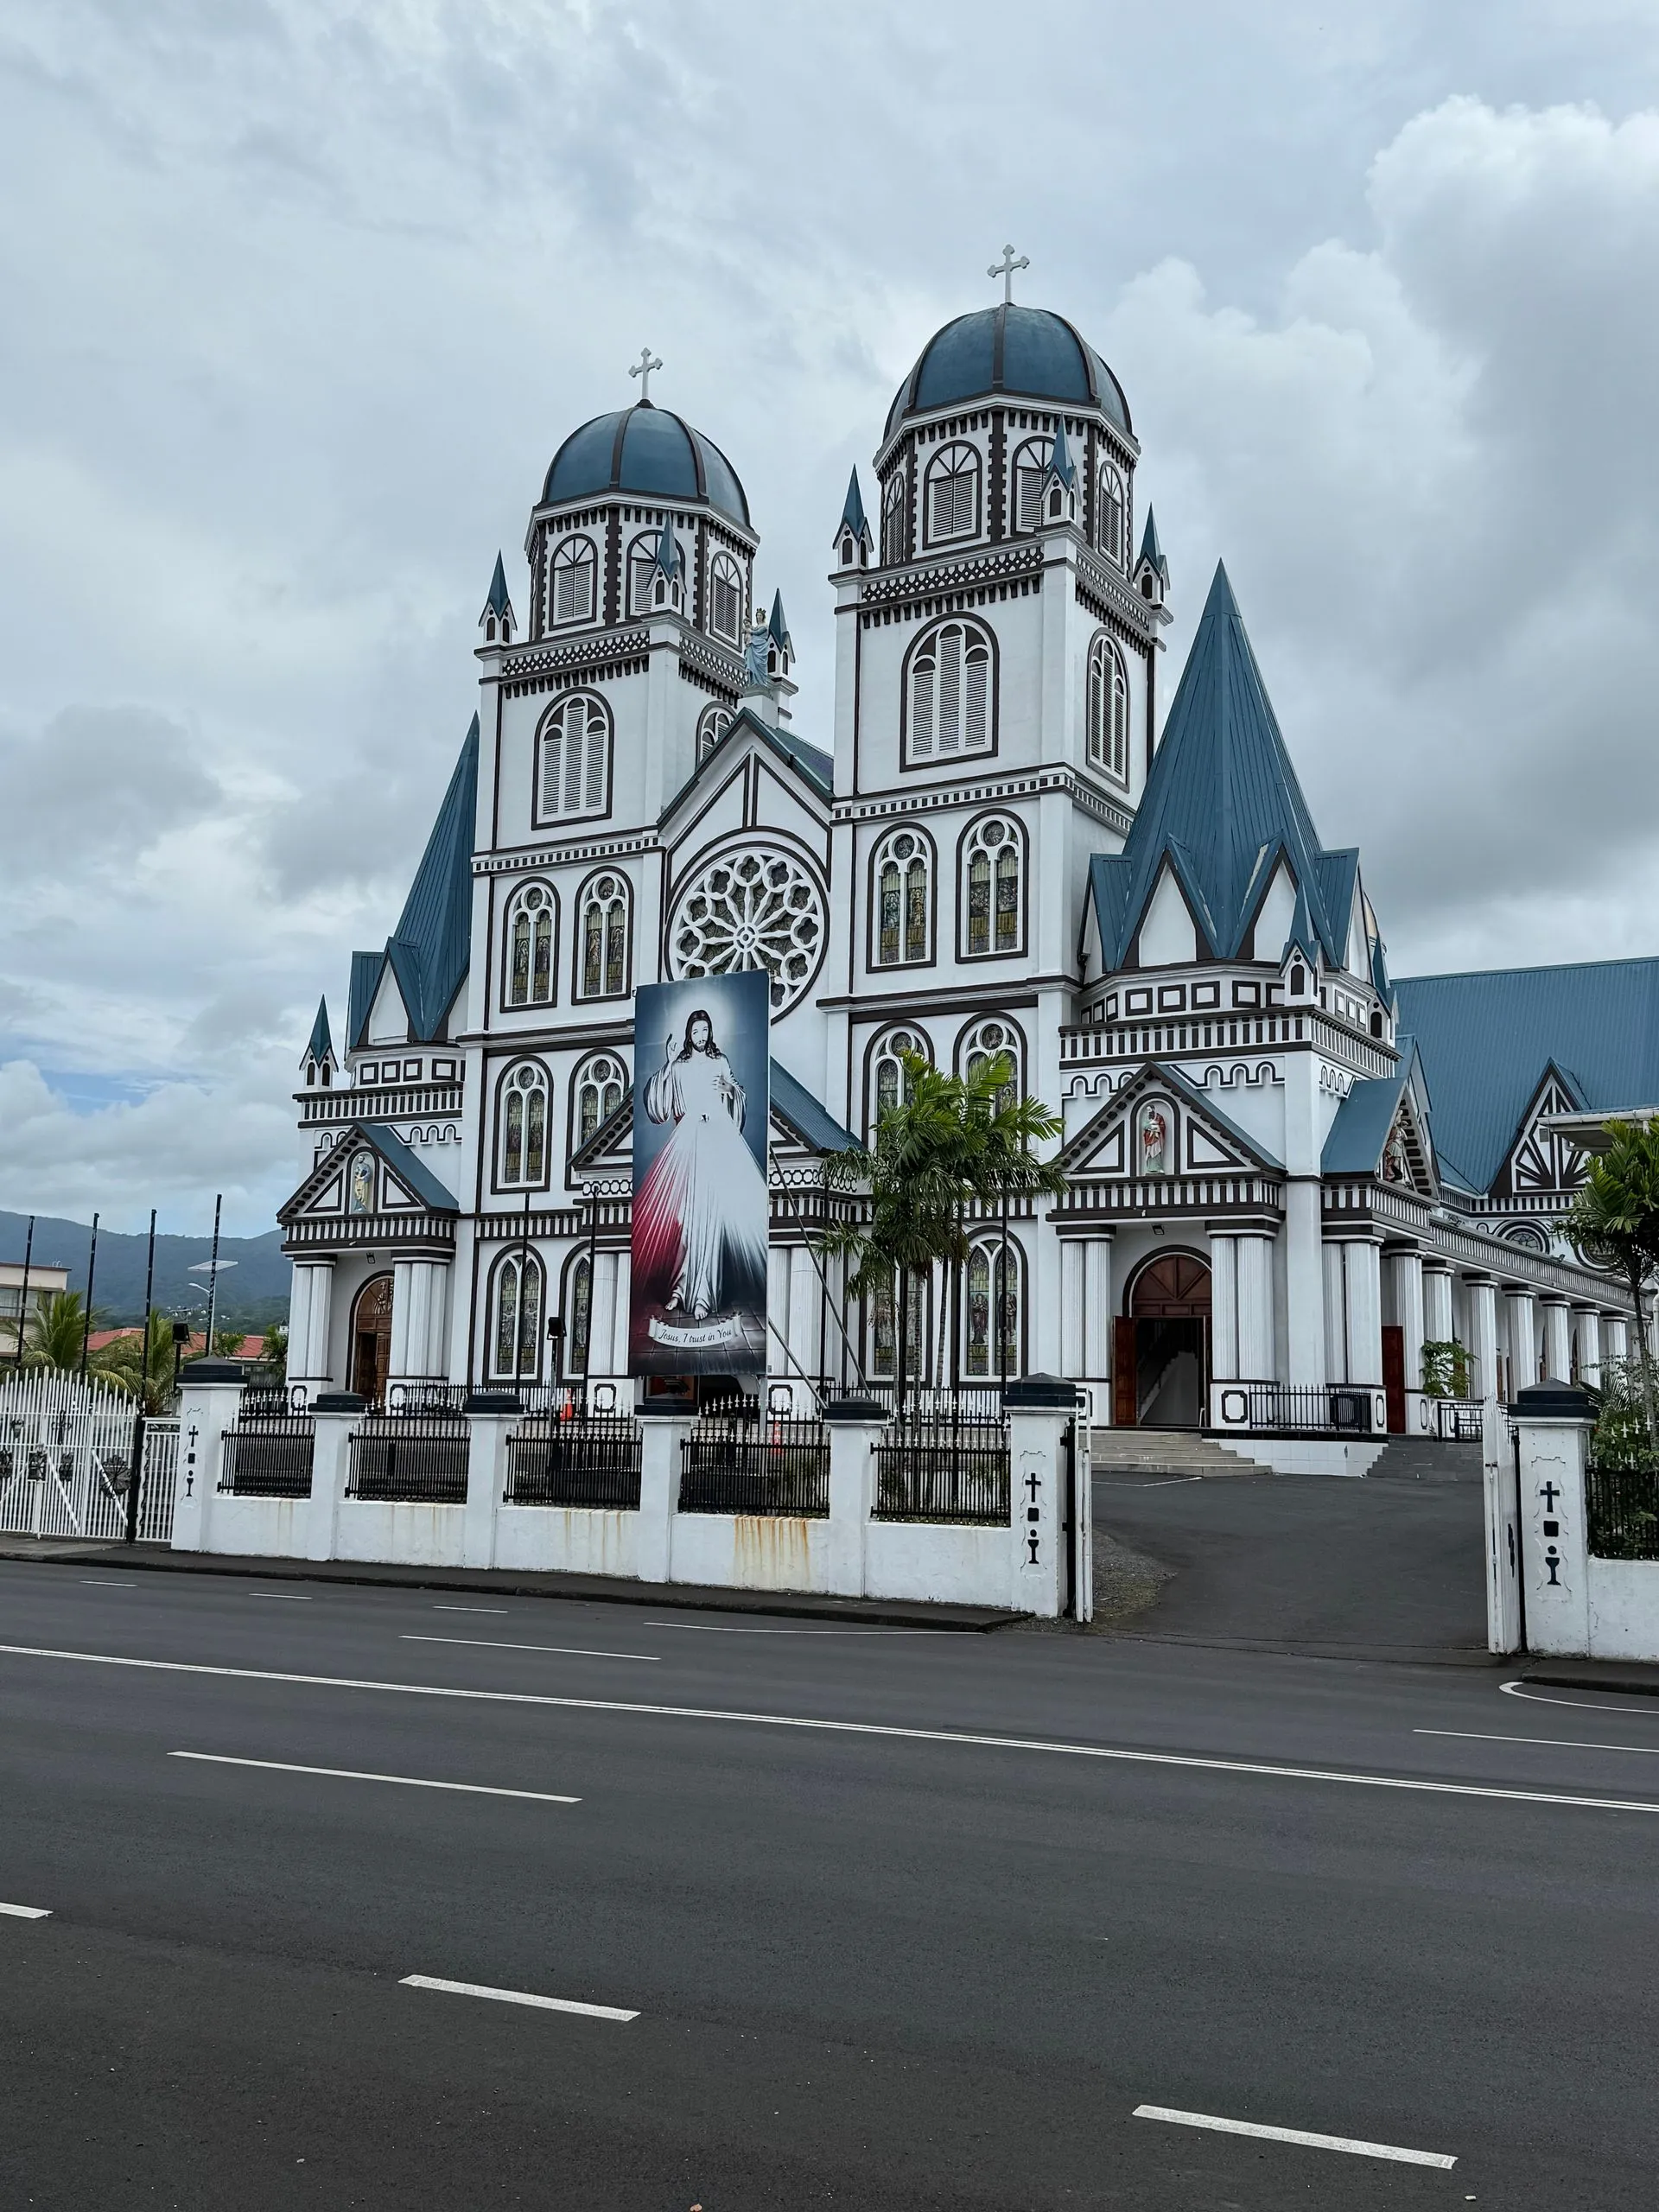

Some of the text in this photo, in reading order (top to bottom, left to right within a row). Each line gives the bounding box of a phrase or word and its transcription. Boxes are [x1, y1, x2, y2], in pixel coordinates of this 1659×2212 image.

[689, 1334, 706, 1343] trust
[708, 1332, 715, 1341] in
[717, 1329, 732, 1338] You
